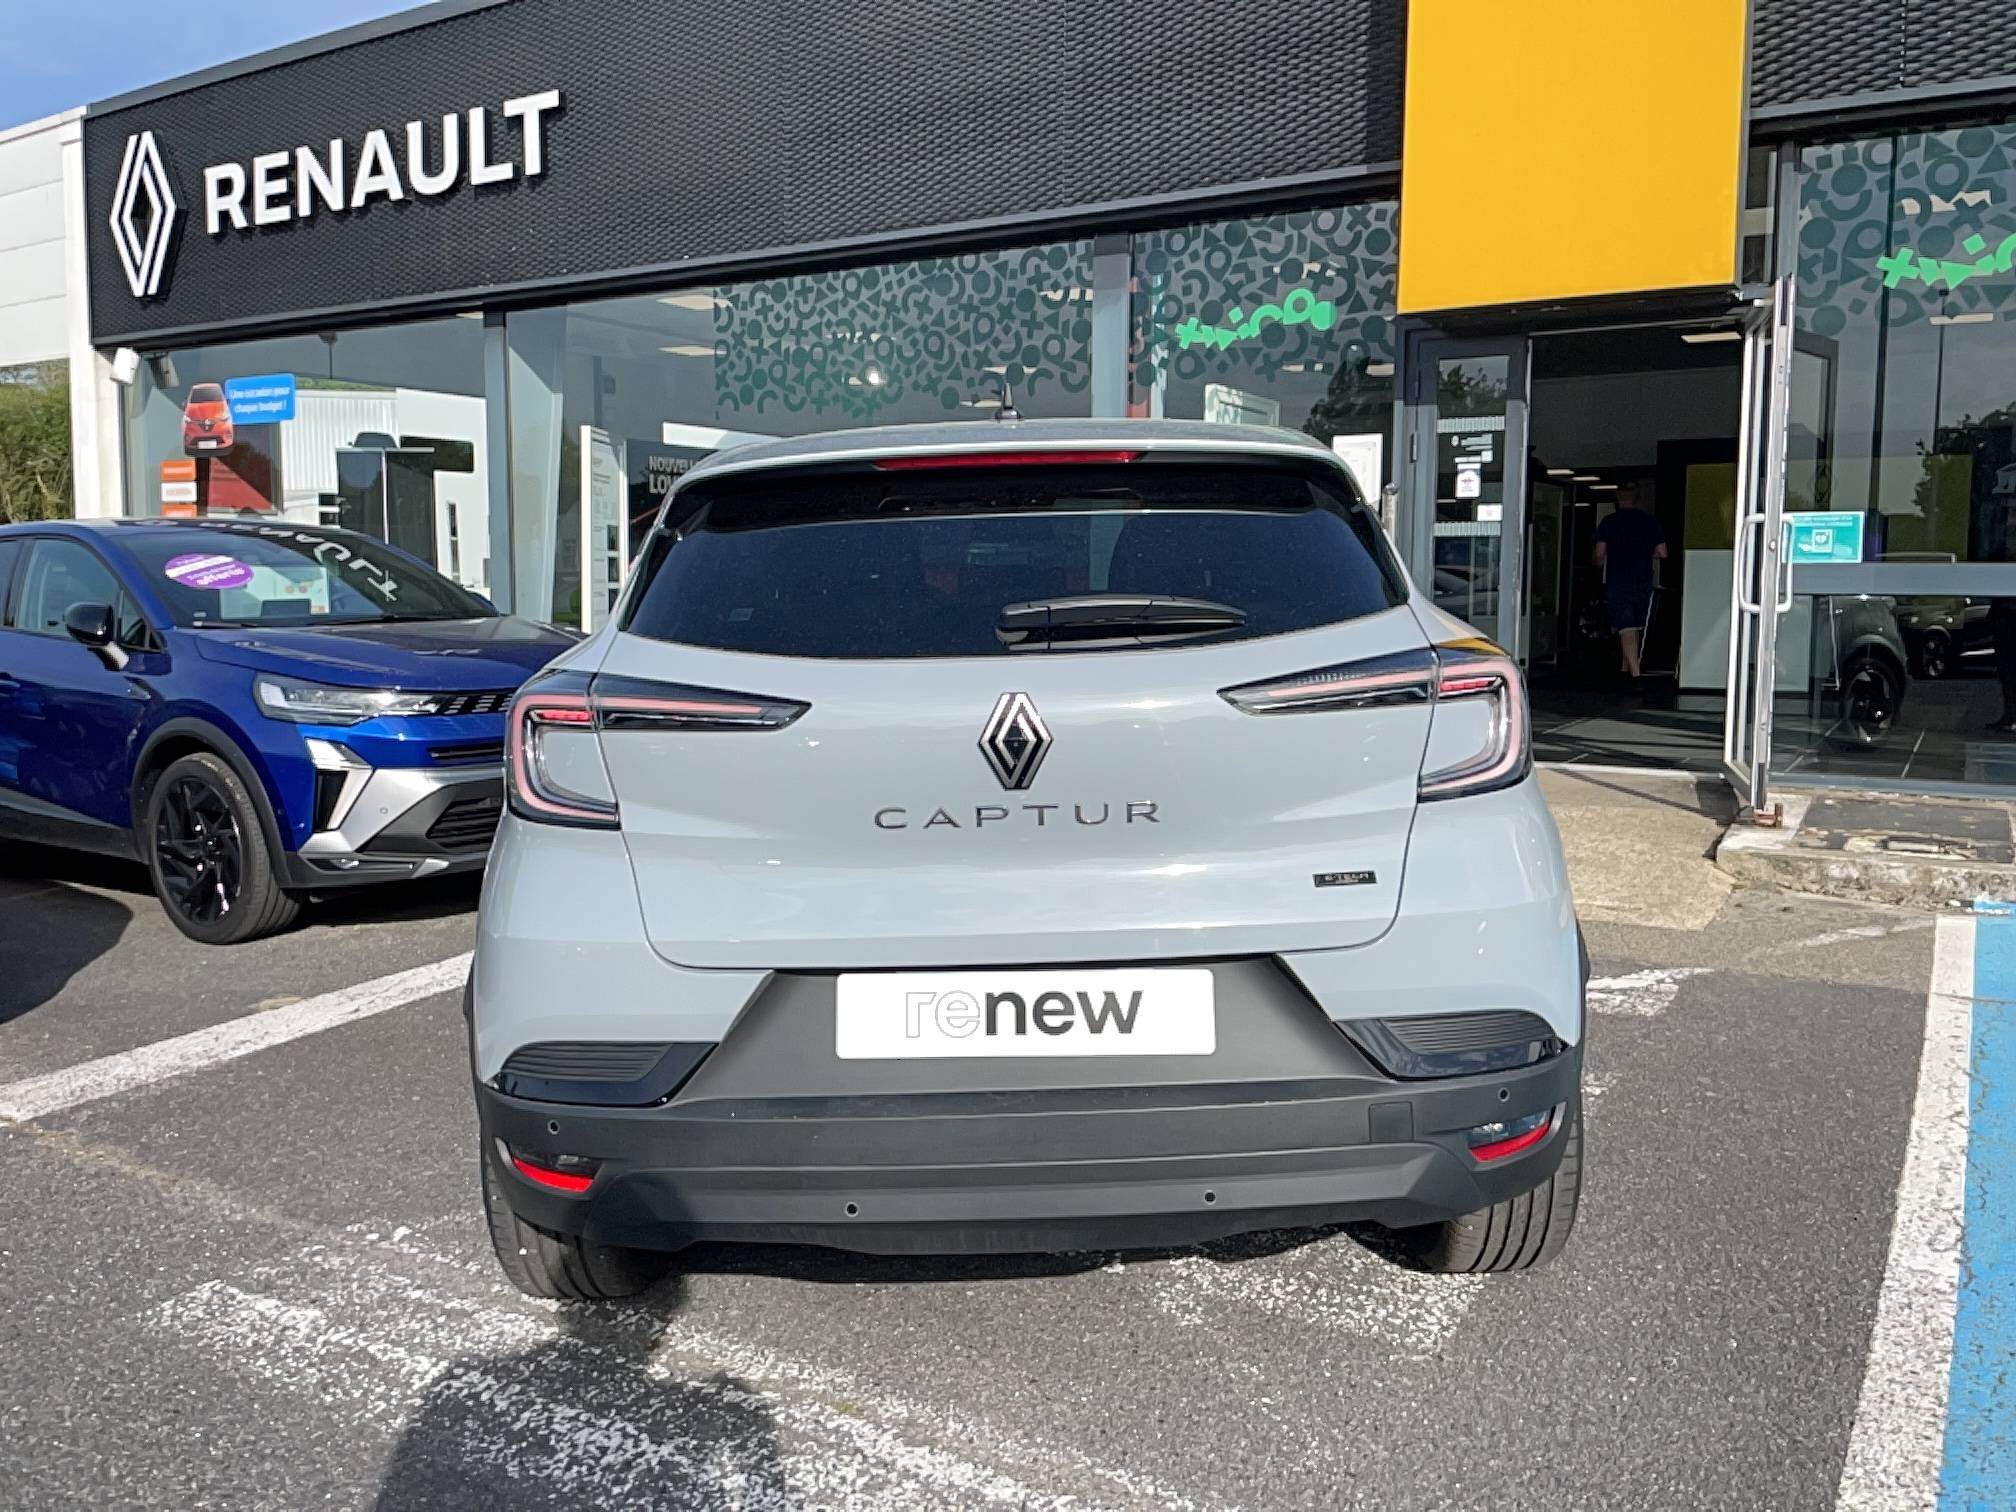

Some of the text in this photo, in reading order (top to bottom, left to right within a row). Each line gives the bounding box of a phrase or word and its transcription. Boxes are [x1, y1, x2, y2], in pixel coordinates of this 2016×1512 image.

[203, 89, 561, 234] RENAULT
[874, 800, 1161, 829] CAPTUR
[905, 989, 1144, 1038] renew
